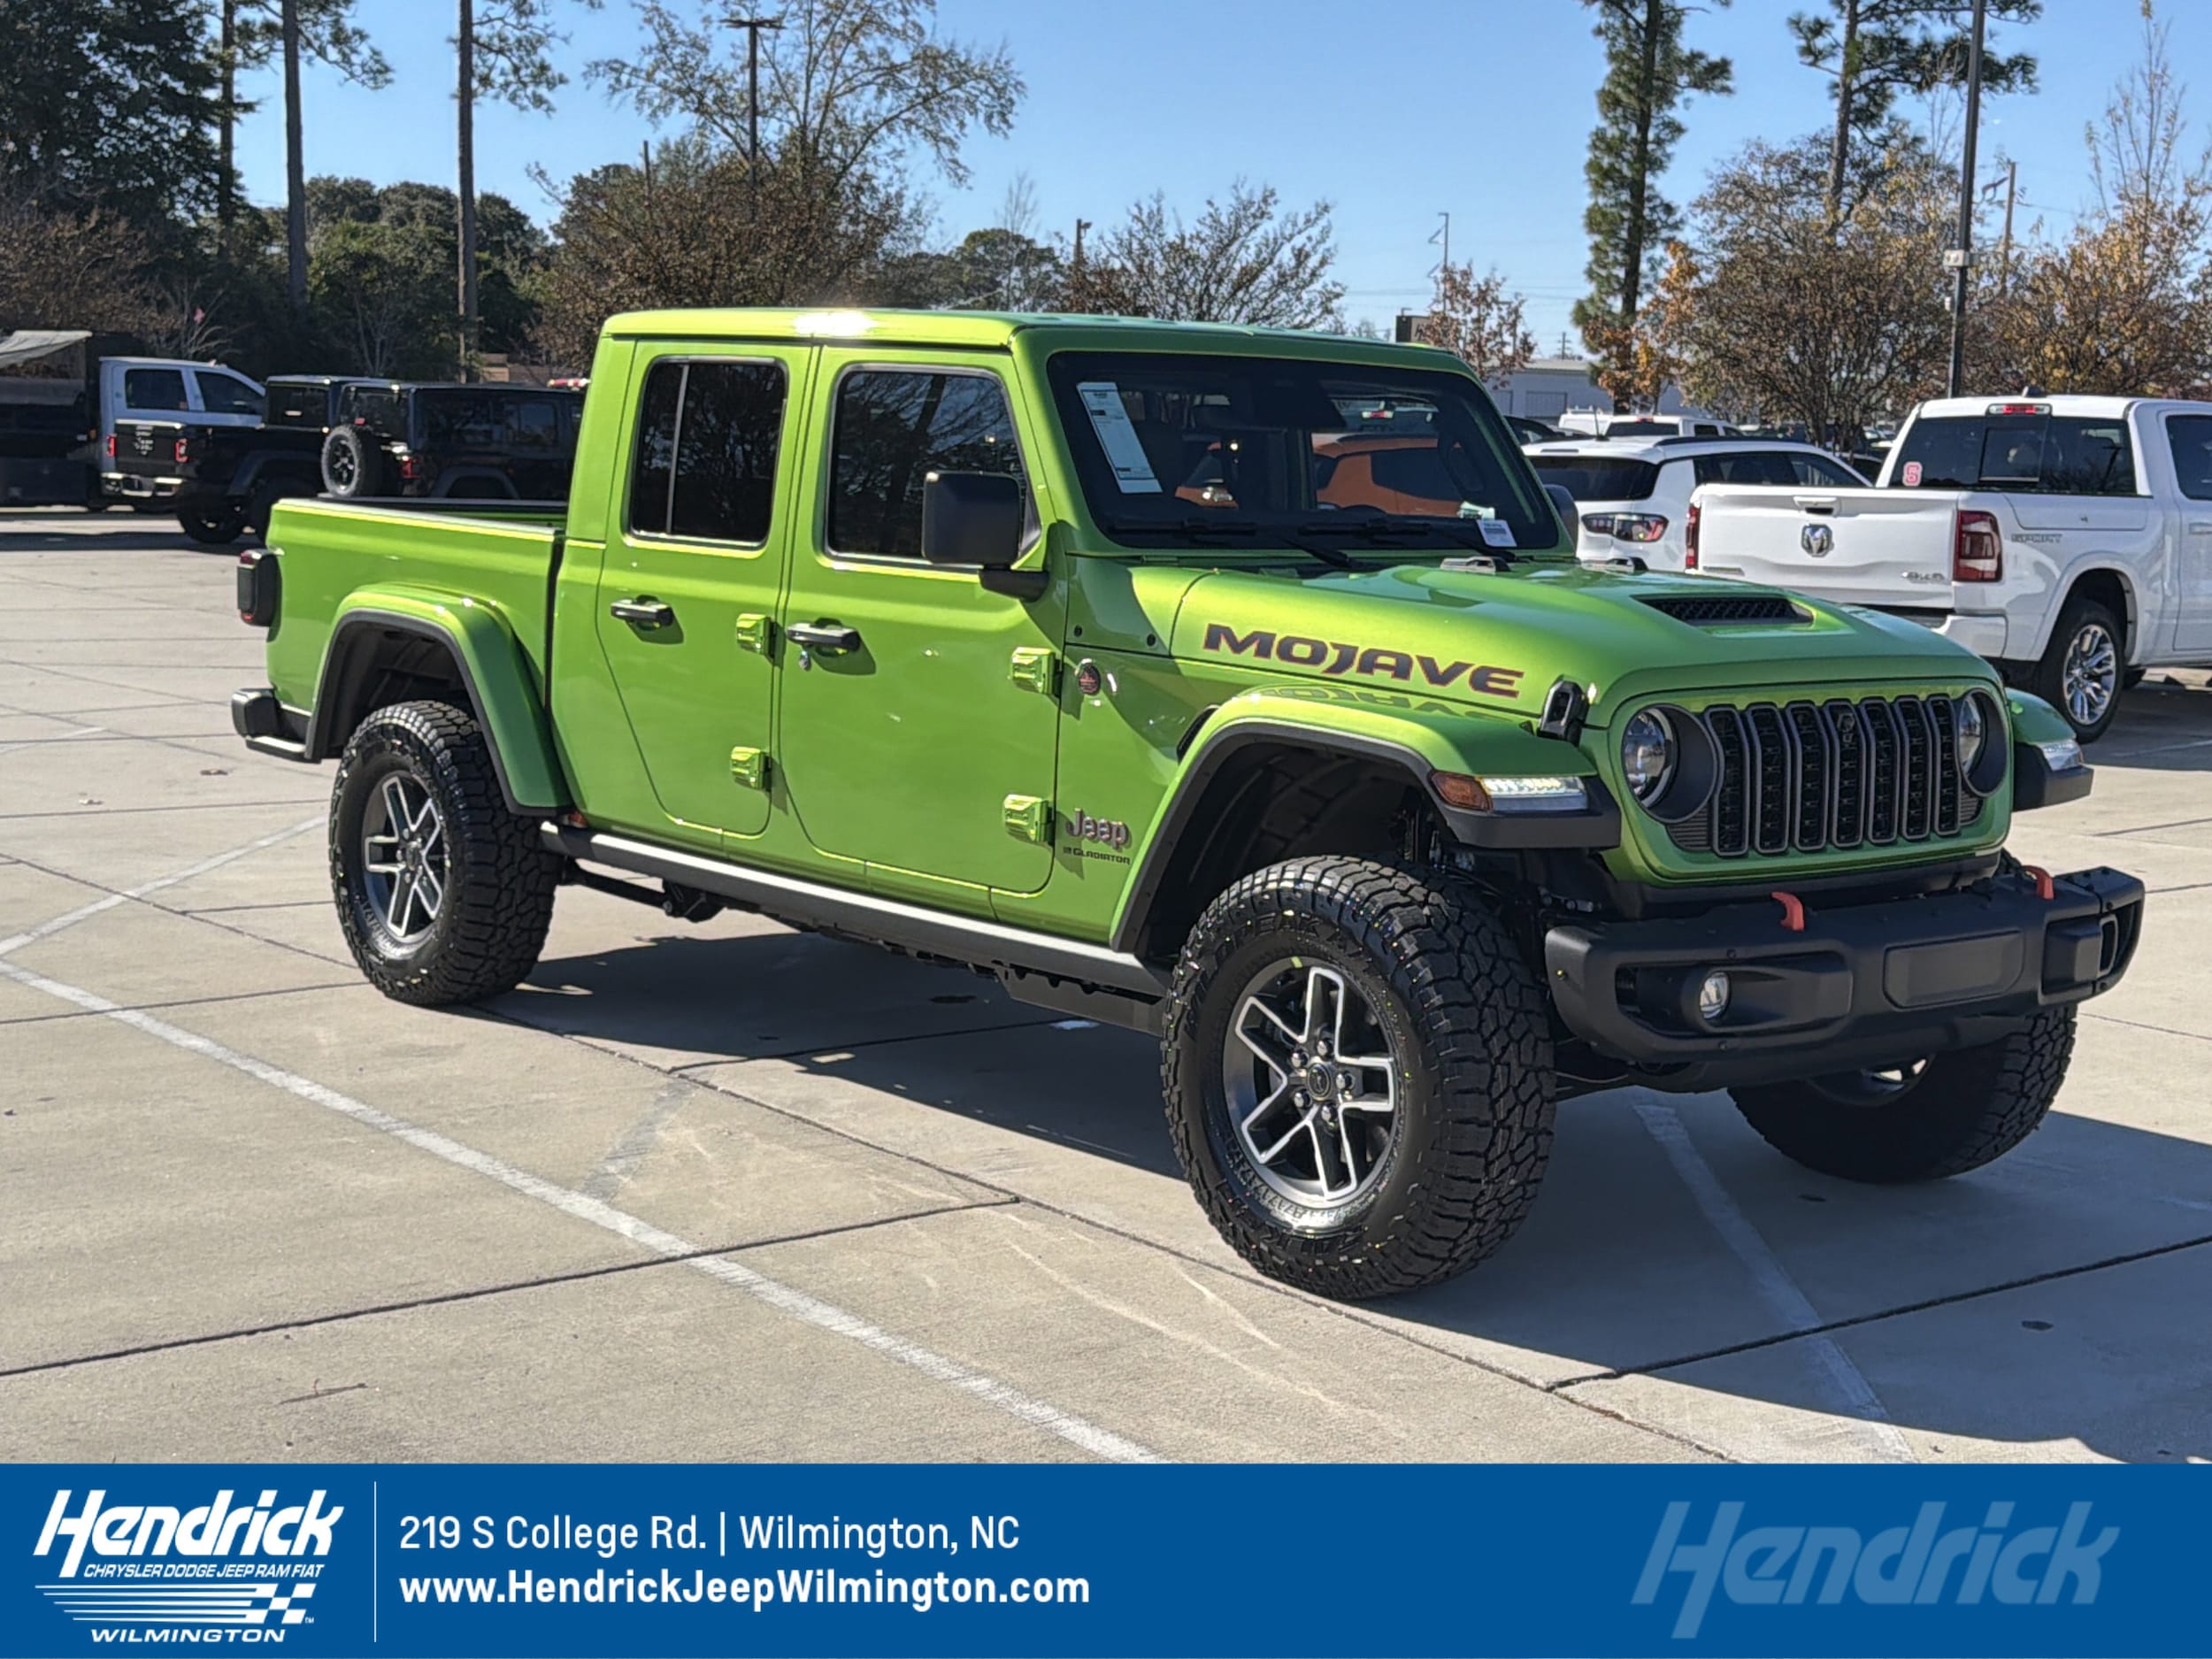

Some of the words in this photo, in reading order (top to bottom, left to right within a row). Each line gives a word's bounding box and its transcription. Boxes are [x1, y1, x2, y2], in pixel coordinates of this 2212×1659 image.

[1202, 623, 1525, 699] MOJAVE
[1065, 807, 1130, 850] Jeep
[1072, 849, 1131, 865] GLADIATOR
